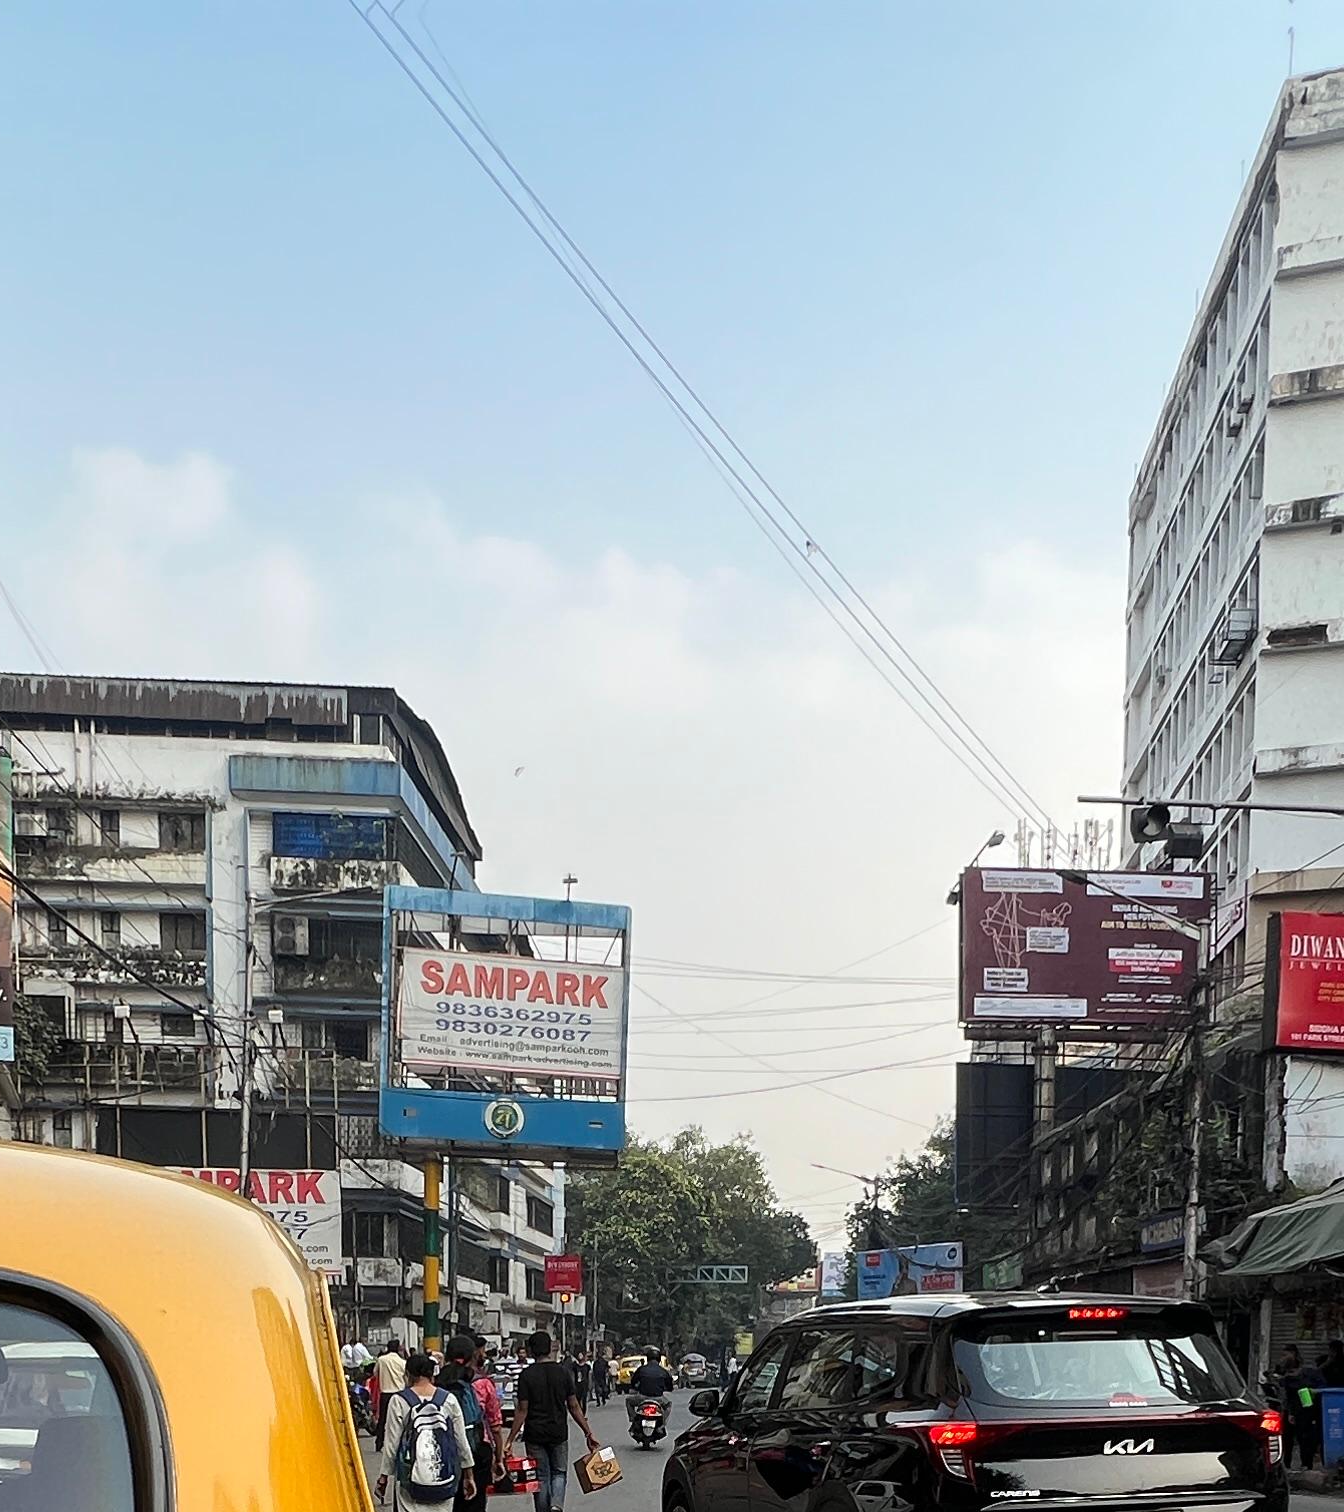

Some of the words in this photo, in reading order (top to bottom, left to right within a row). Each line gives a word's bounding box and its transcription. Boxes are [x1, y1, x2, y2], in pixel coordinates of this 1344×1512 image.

[421, 960, 608, 1008] SAMPARK
[436, 1002, 592, 1026] 9836362975
[420, 1034, 448, 1043] Email
[436, 1019, 592, 1042] 9830276087
[418, 1046, 457, 1056] Website
[181, 1170, 326, 1204] PARK
[990, 1489, 1041, 1498] CARENS
